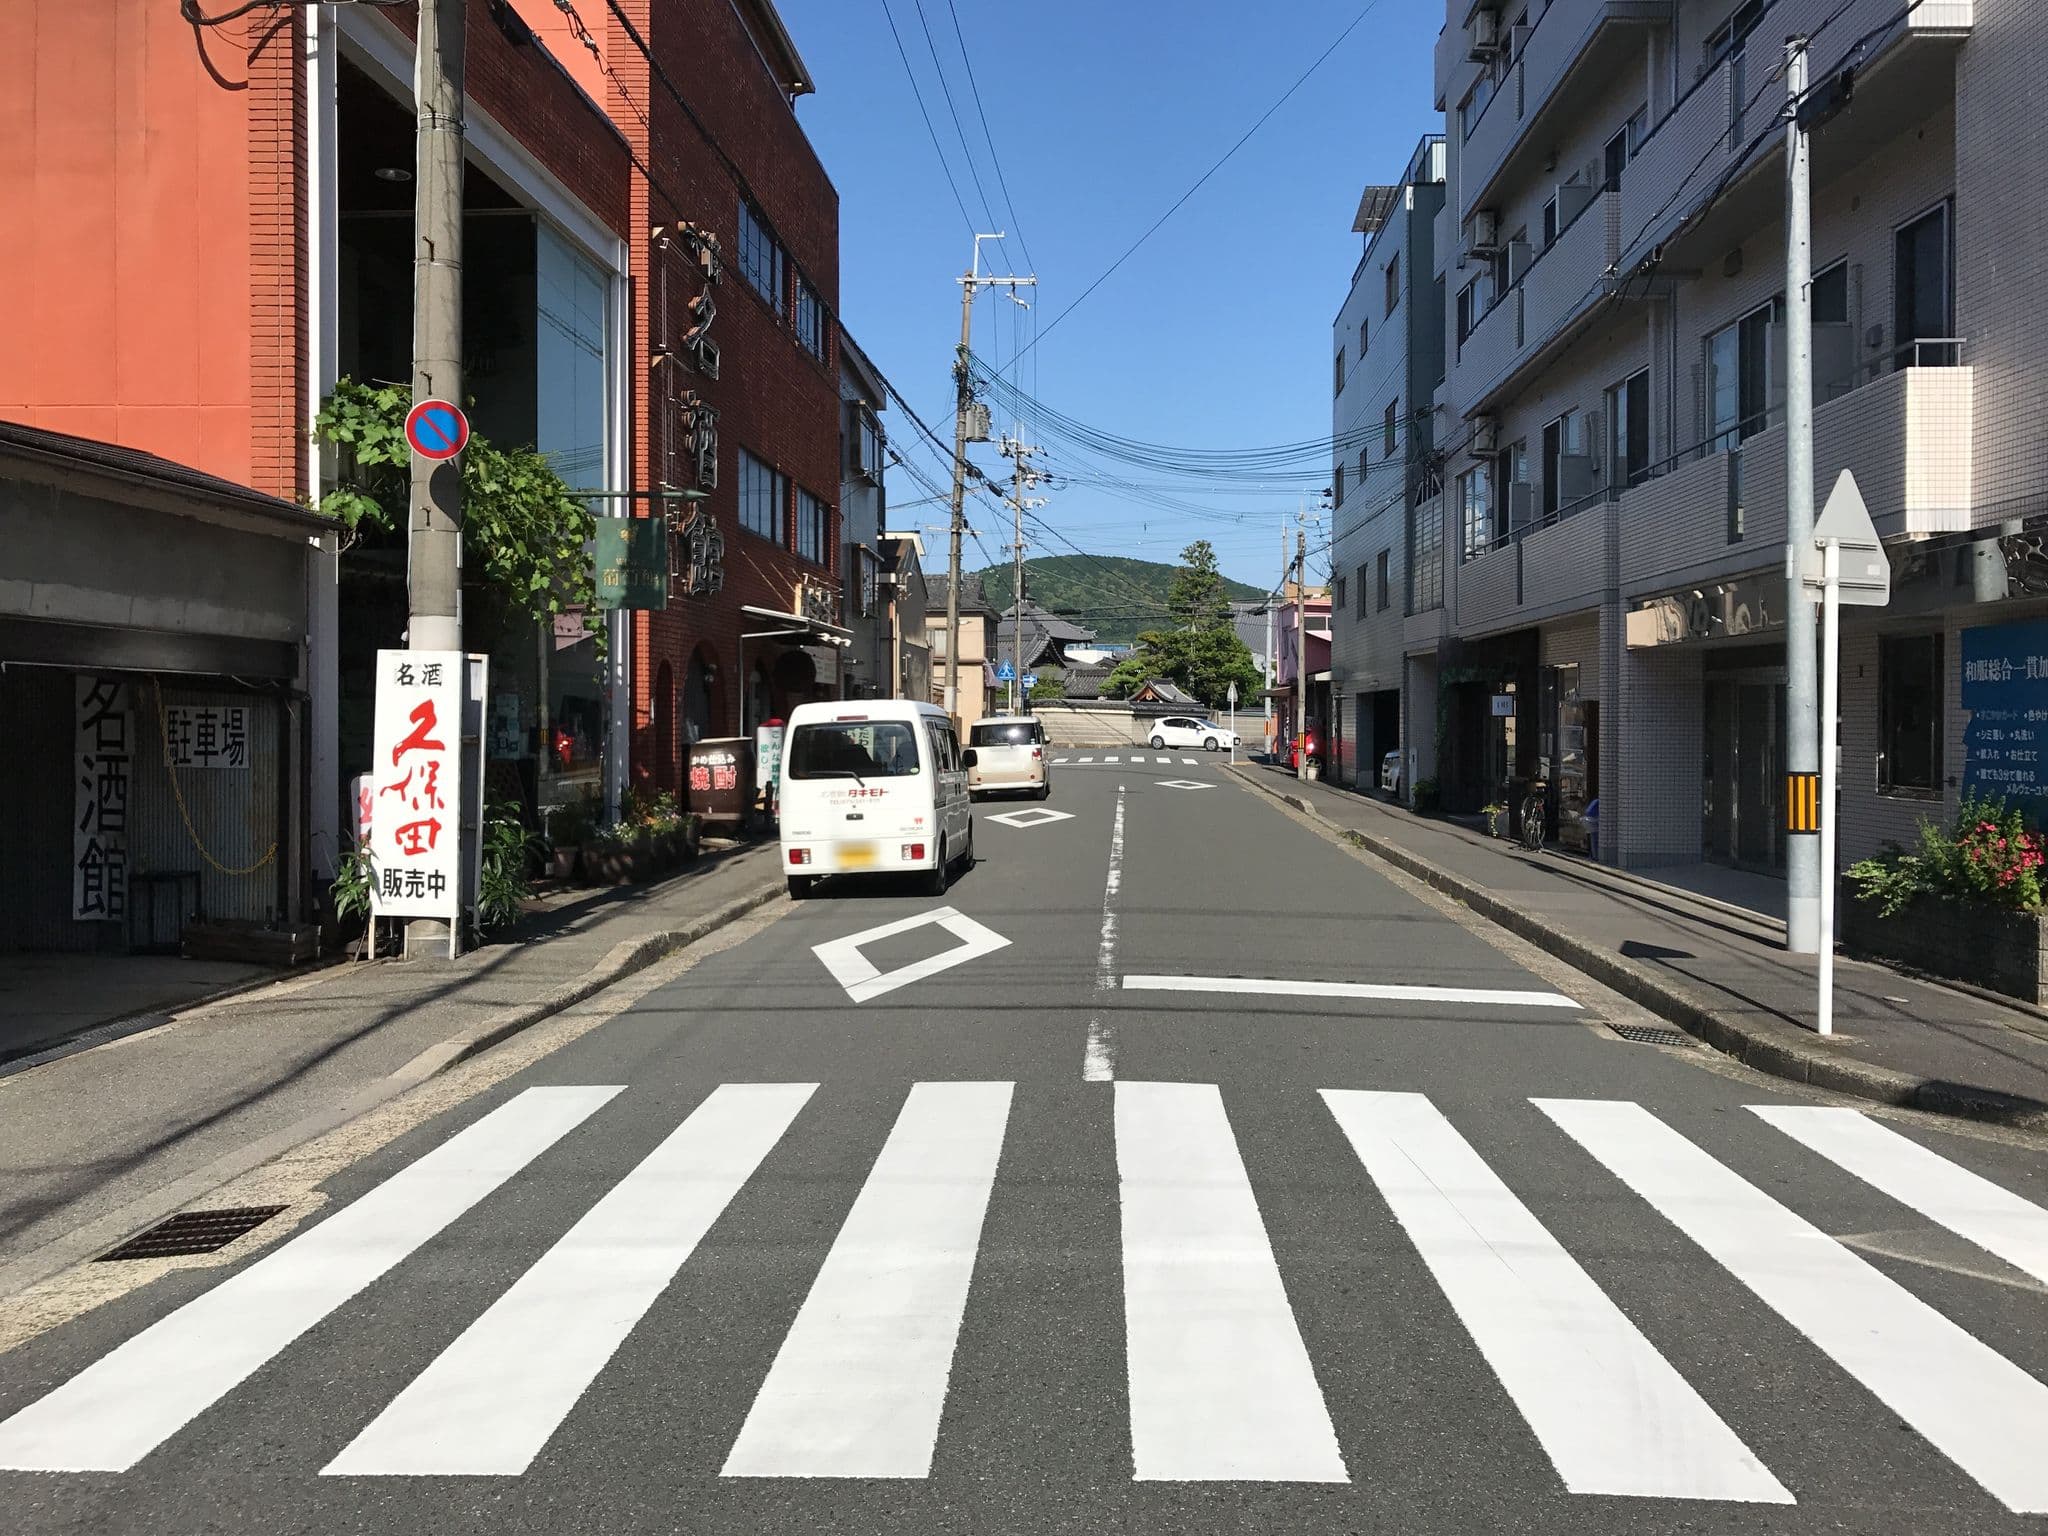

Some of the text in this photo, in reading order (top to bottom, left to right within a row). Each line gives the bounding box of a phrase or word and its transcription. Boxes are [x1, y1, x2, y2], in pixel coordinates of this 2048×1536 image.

[396, 662, 443, 687] 名酒
[166, 708, 246, 768] 駐車場
[379, 699, 446, 856] 久保田
[690, 765, 737, 791] 焼酎
[848, 787, 890, 798] タキモト
[78, 676, 129, 919] 名酒館
[382, 868, 446, 900] 販売中
